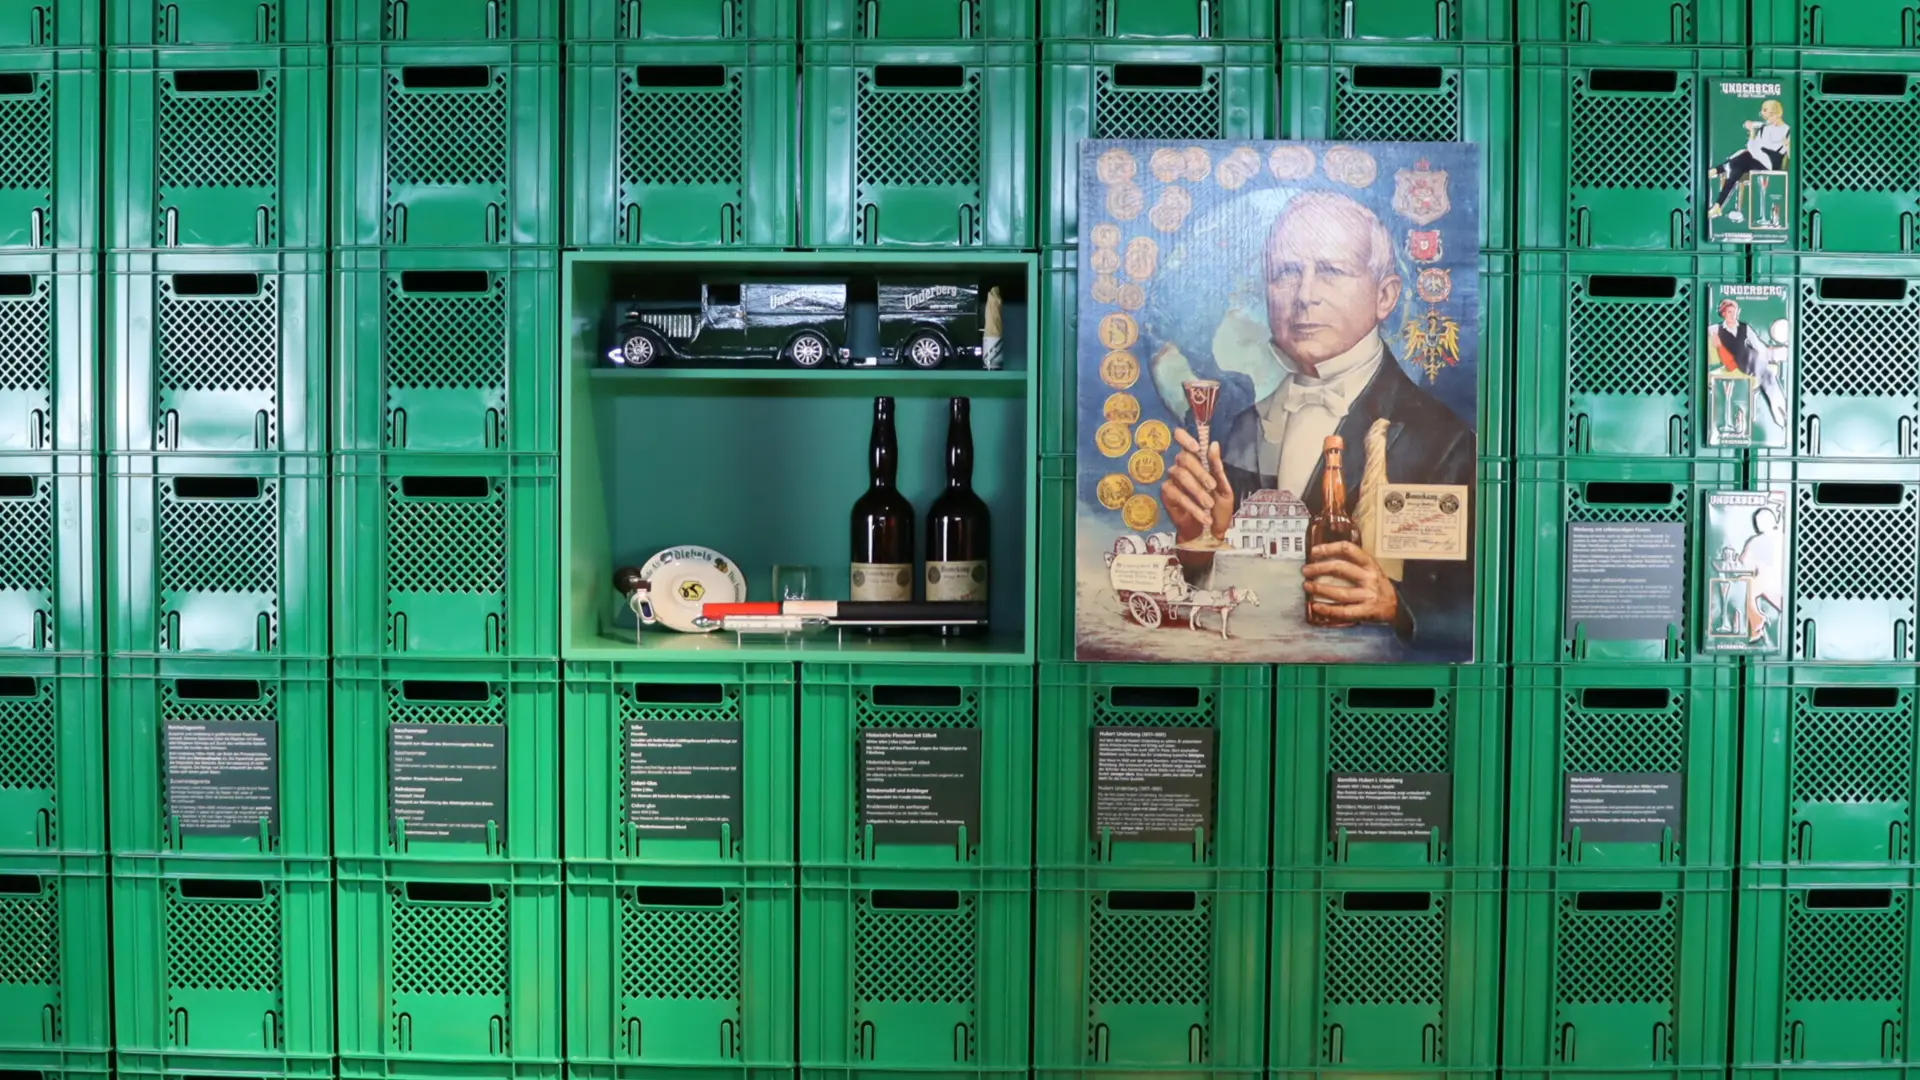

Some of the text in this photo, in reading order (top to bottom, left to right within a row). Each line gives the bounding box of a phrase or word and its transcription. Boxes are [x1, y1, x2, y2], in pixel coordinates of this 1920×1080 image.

[1720, 82, 1781, 95] UNDERBERG
[1722, 285, 1783, 296] UNDERBERG
[904, 285, 957, 310] Underberg
[1710, 495, 1766, 505] UNDERBERG
